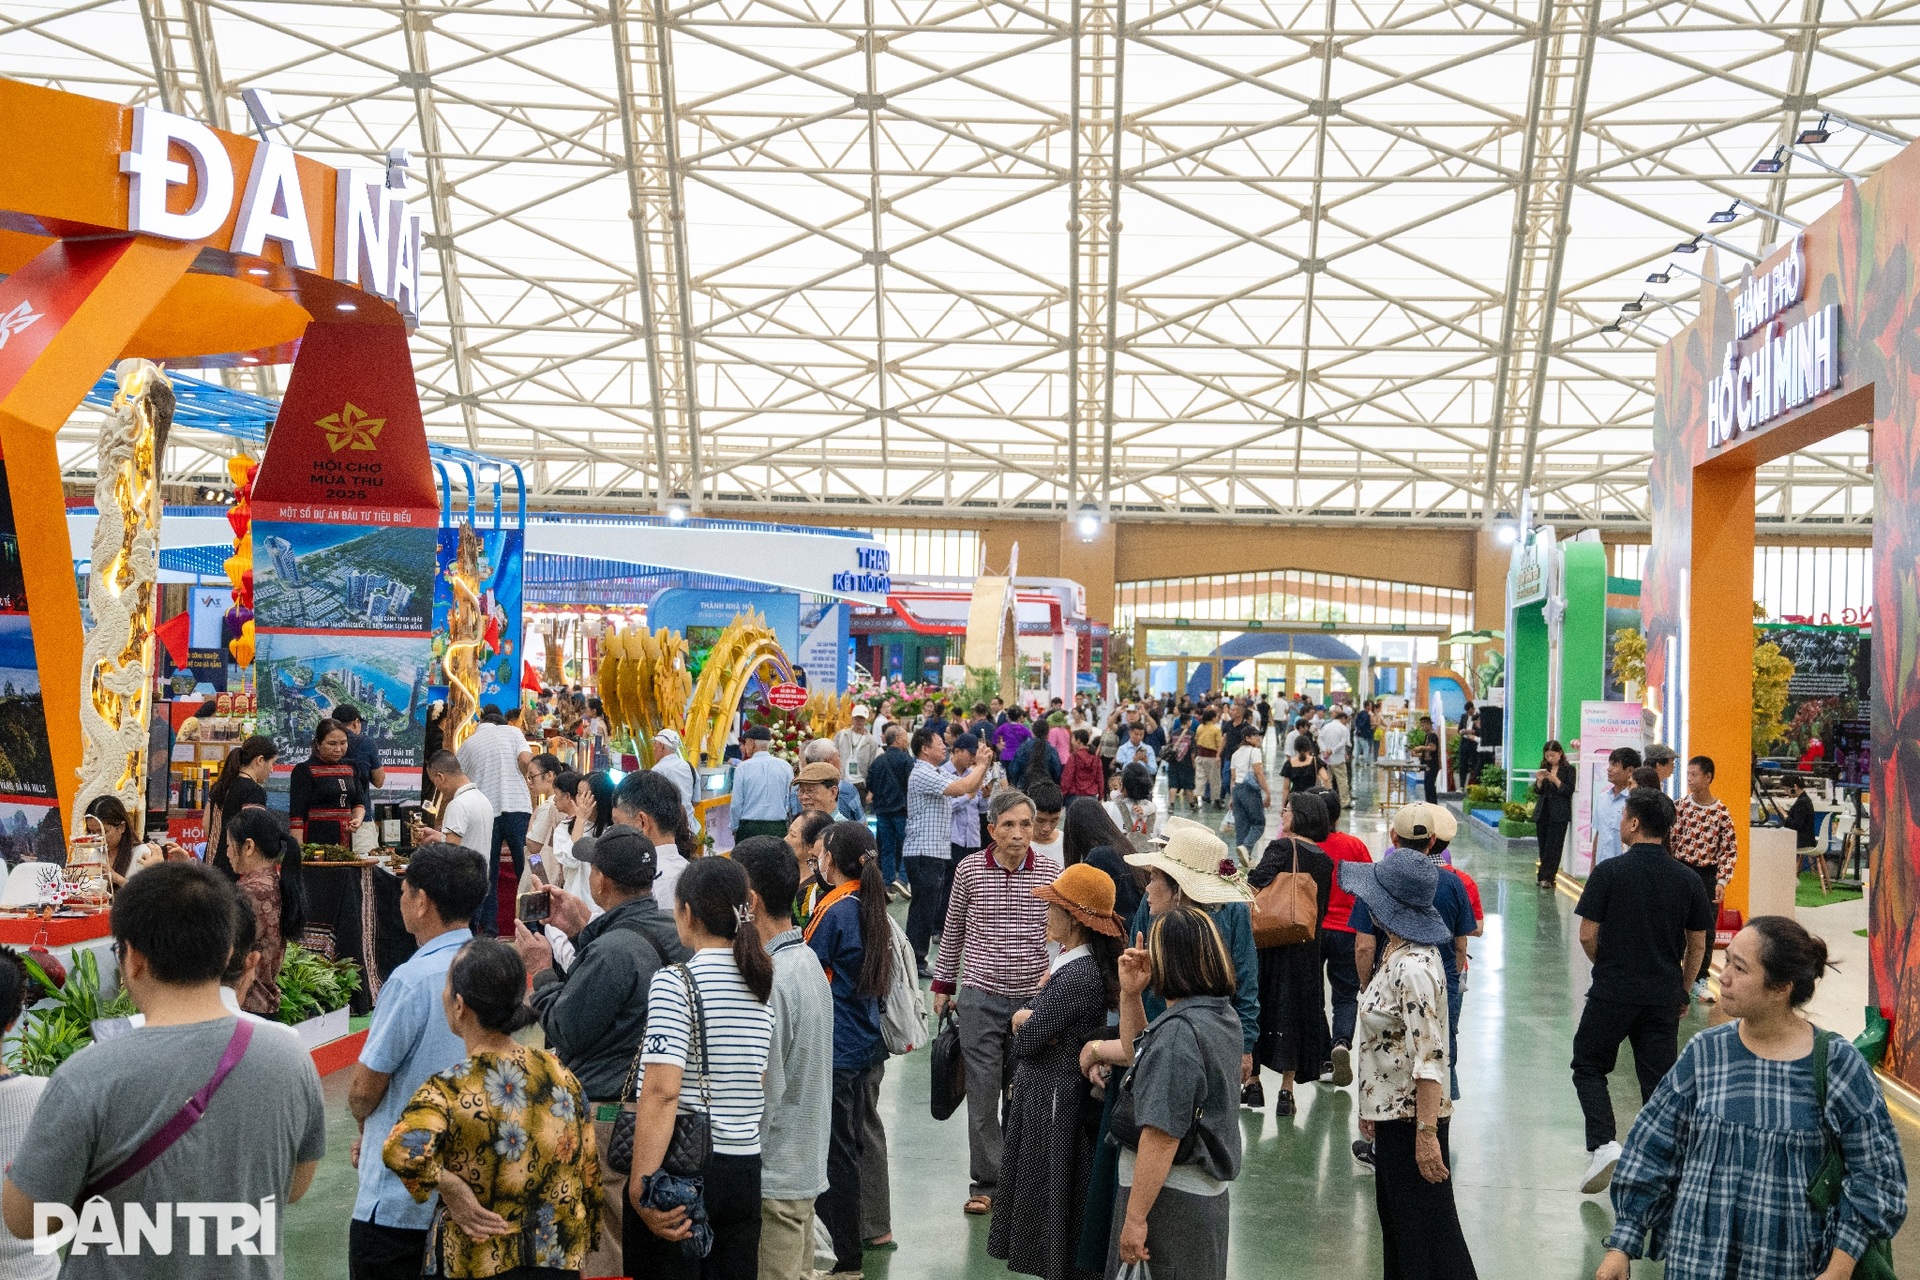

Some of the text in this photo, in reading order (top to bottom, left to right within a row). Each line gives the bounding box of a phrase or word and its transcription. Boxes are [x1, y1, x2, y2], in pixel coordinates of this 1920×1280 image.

[119, 88, 316, 270] ĐÀ
[1734, 233, 1806, 340] THÀNH PHỐ
[1737, 321, 1777, 432] CHÍ
[1774, 304, 1840, 416] MINH
[313, 460, 382, 475] HỘI CHỢ
[310, 474, 384, 487] MÙA THU
[326, 489, 367, 499] 2025
[279, 506, 297, 520] MỘT
[299, 505, 311, 519] SỐ
[313, 508, 324, 522] DỰ
[327, 507, 339, 519] ÁN
[360, 510, 372, 521] TƯ
[373, 510, 391, 522] TIÊU
[393, 510, 412, 523] BIỂU
[31, 783, 47, 793] HILLS
[182, 827, 205, 840] HỘI
